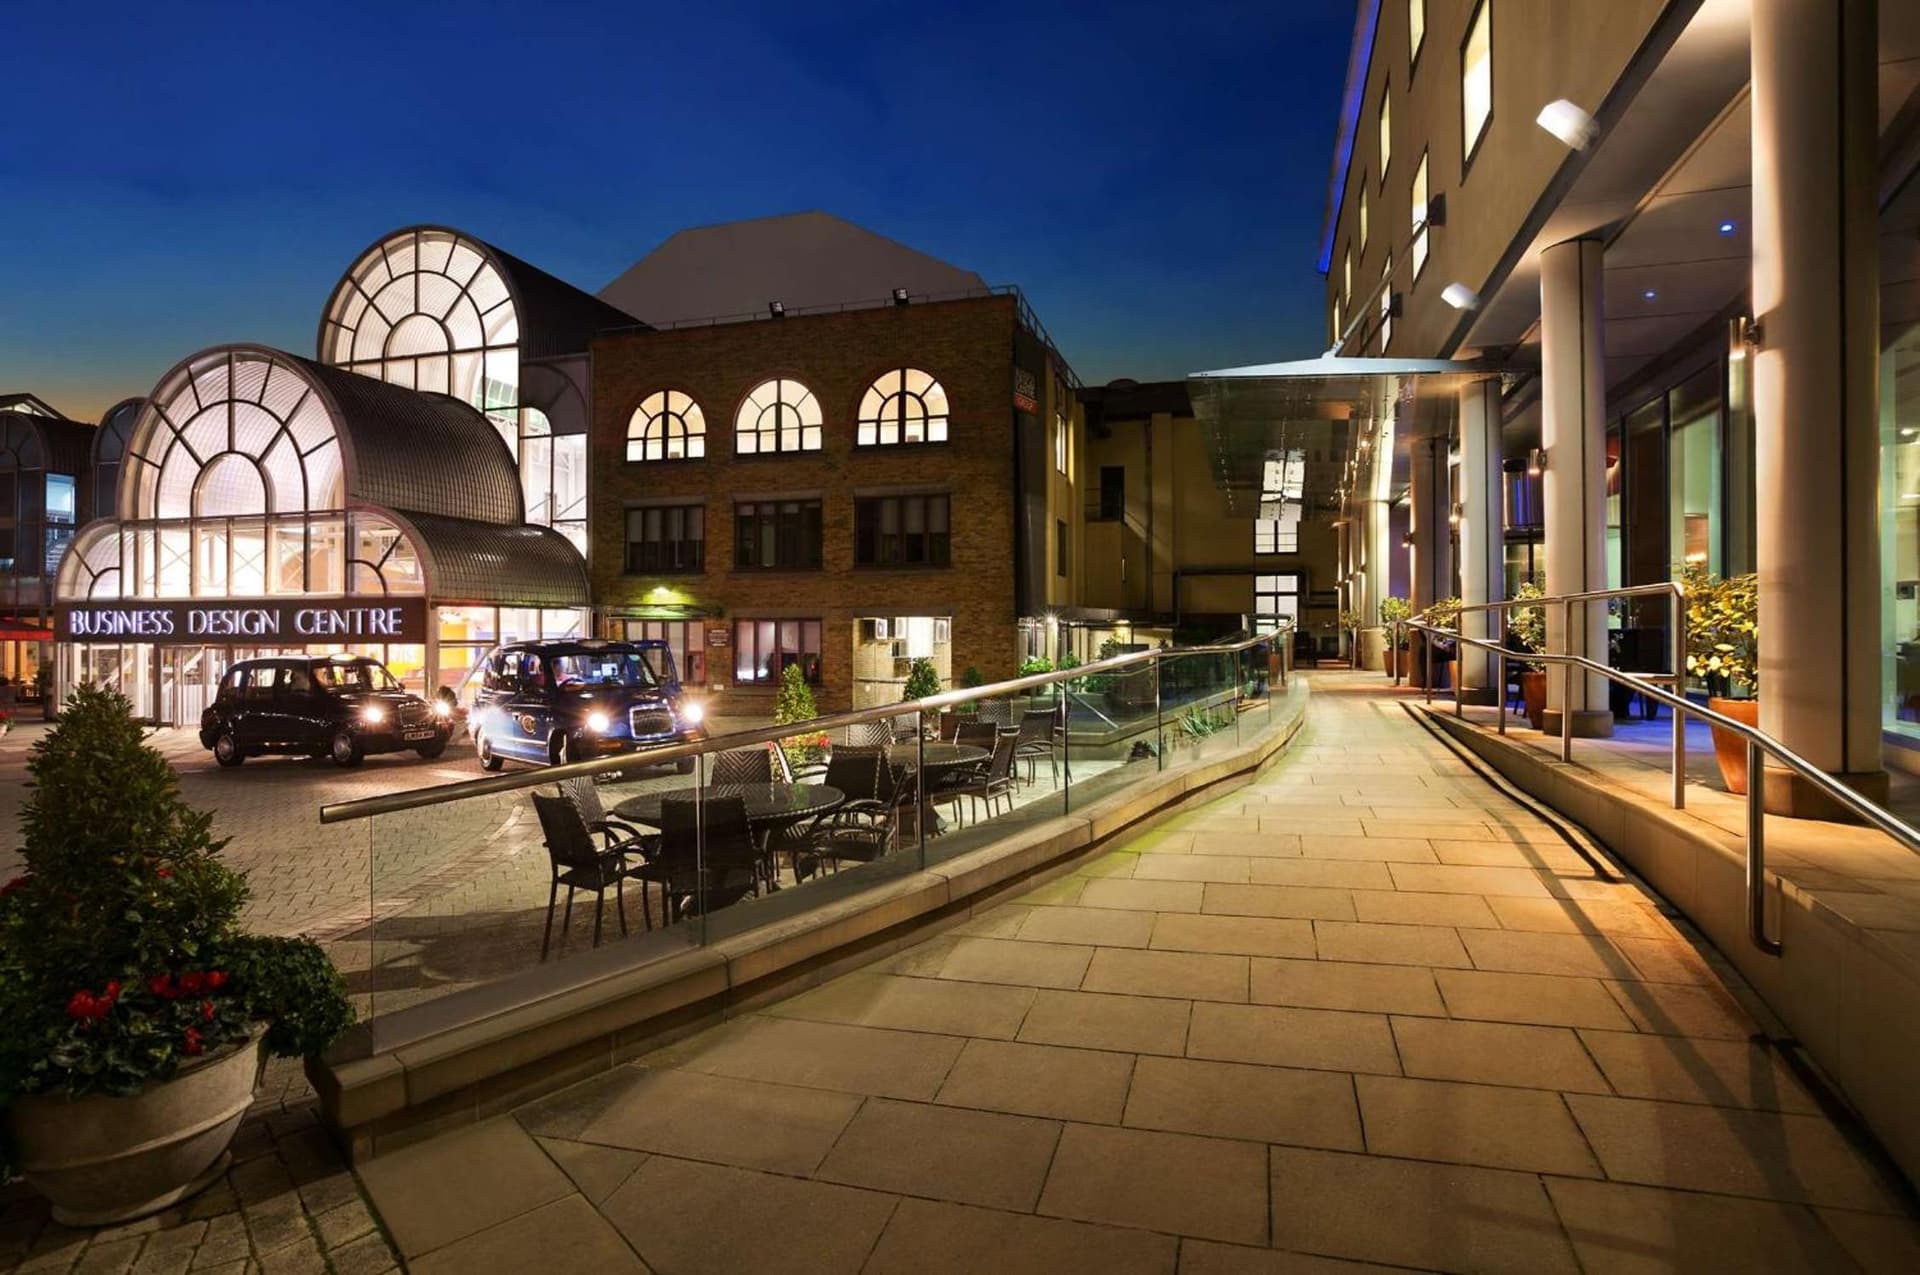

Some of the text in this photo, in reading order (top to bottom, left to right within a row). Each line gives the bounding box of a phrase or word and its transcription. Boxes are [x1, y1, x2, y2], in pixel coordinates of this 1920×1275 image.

[70, 608, 403, 635] BUSINESS DESIGN CENTRE
